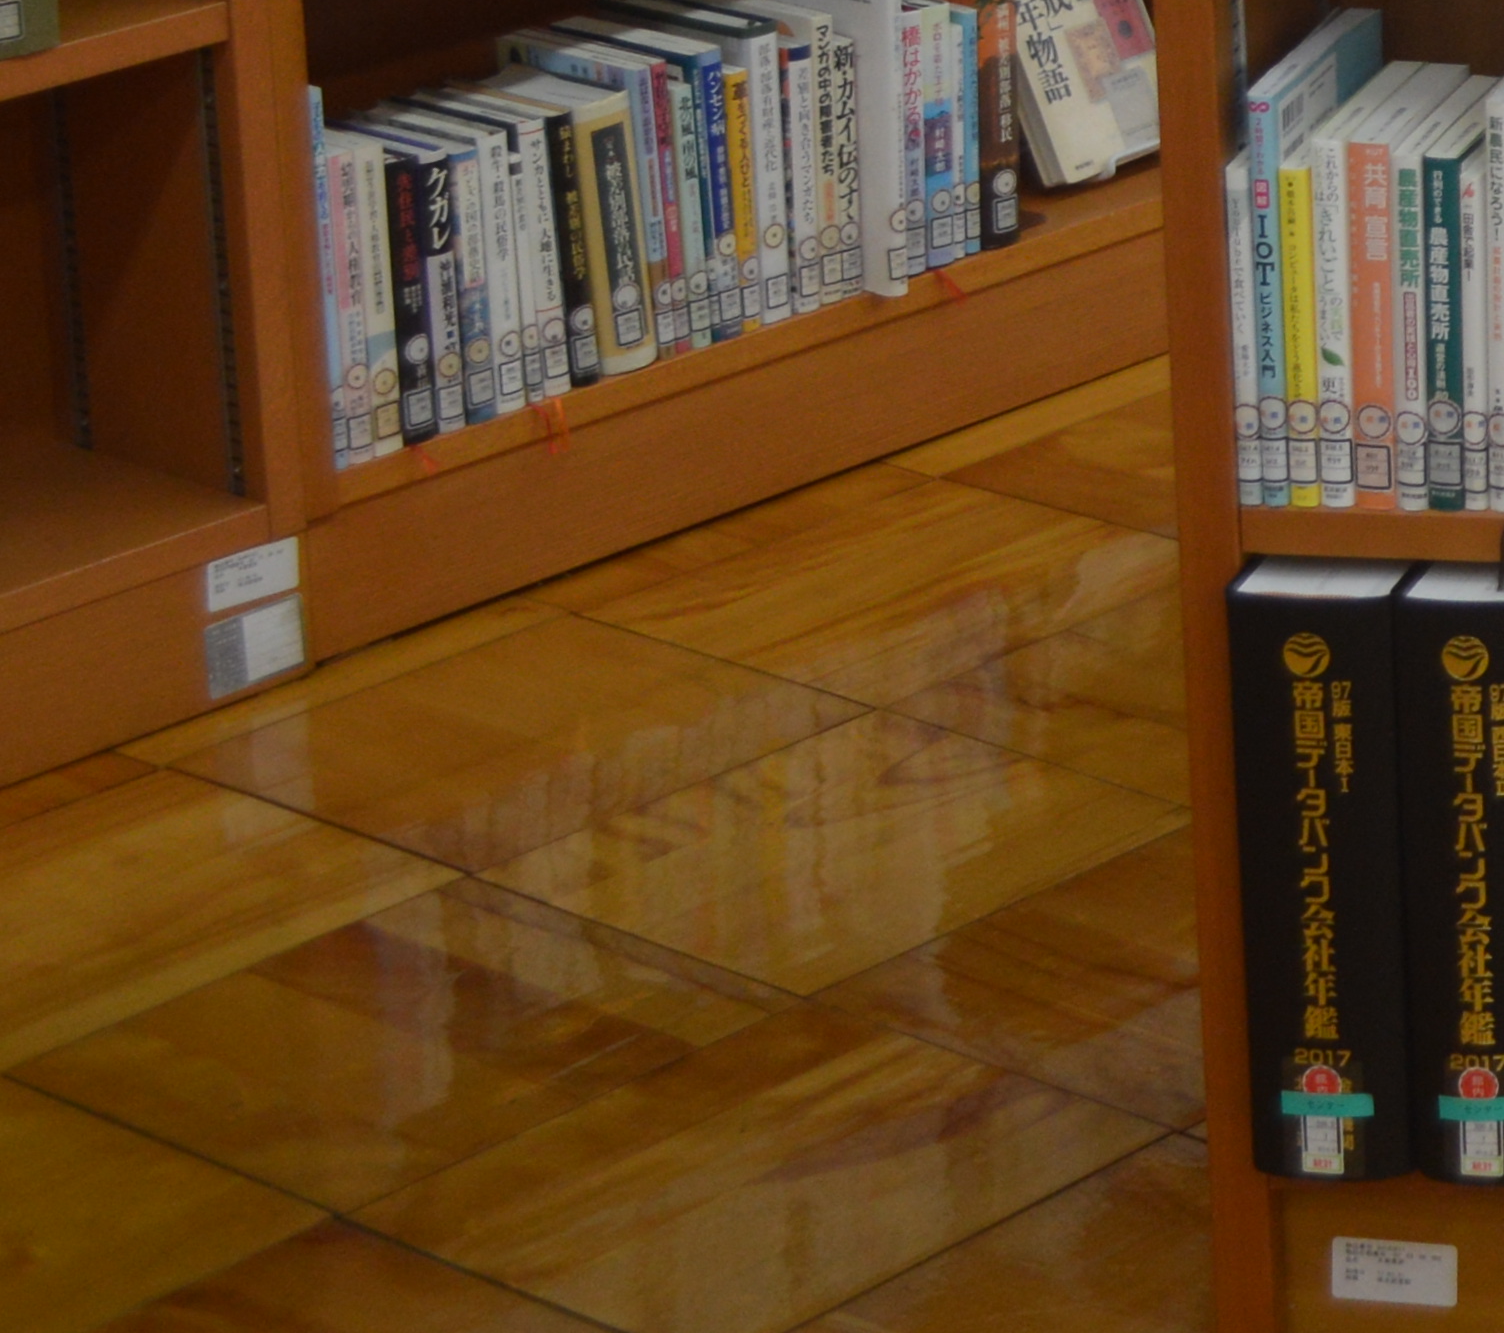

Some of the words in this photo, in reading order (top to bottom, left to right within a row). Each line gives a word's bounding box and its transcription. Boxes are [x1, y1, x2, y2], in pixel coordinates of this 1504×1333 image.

[426, 163, 455, 252] ケガレ
[1330, 680, 1353, 718] 97版
[1291, 680, 1340, 1041] 帝国データバンク会社年鑑
[1450, 685, 1496, 1046] 帝国データバンク会社年鑑
[1293, 1048, 1351, 1067] 2017
